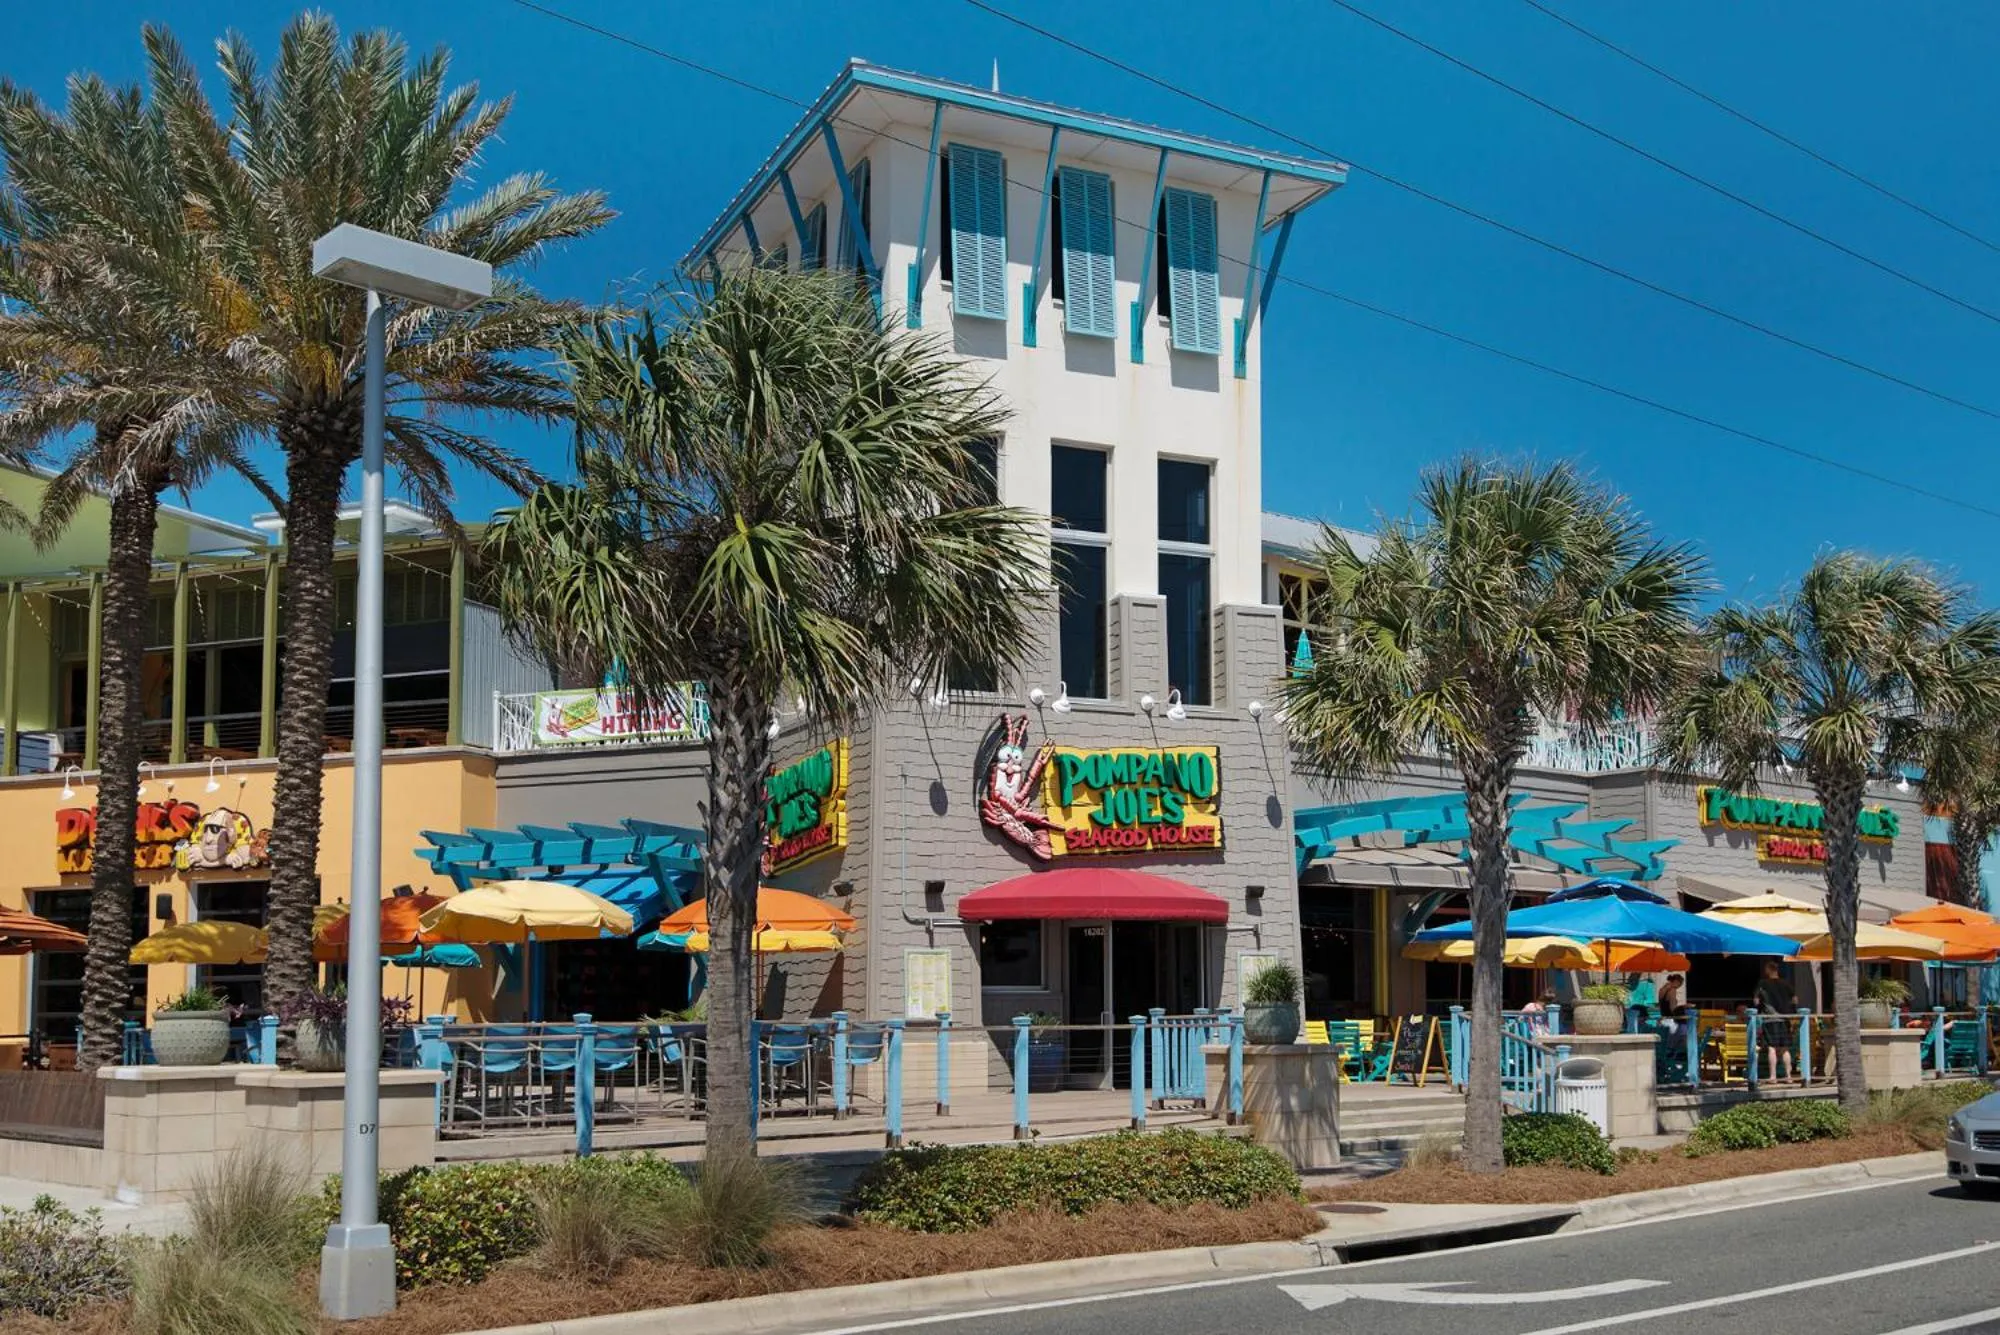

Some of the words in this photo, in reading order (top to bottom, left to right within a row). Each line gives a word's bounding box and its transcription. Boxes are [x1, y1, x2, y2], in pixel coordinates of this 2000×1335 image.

[1056, 752, 1214, 808] POMPANO
[1089, 786, 1186, 826] JOE'S
[1706, 787, 1825, 830] POMPAN
[1065, 828, 1148, 850] SEAFOOD
[1152, 825, 1215, 844] HOUSE
[359, 1123, 376, 1135] D7
